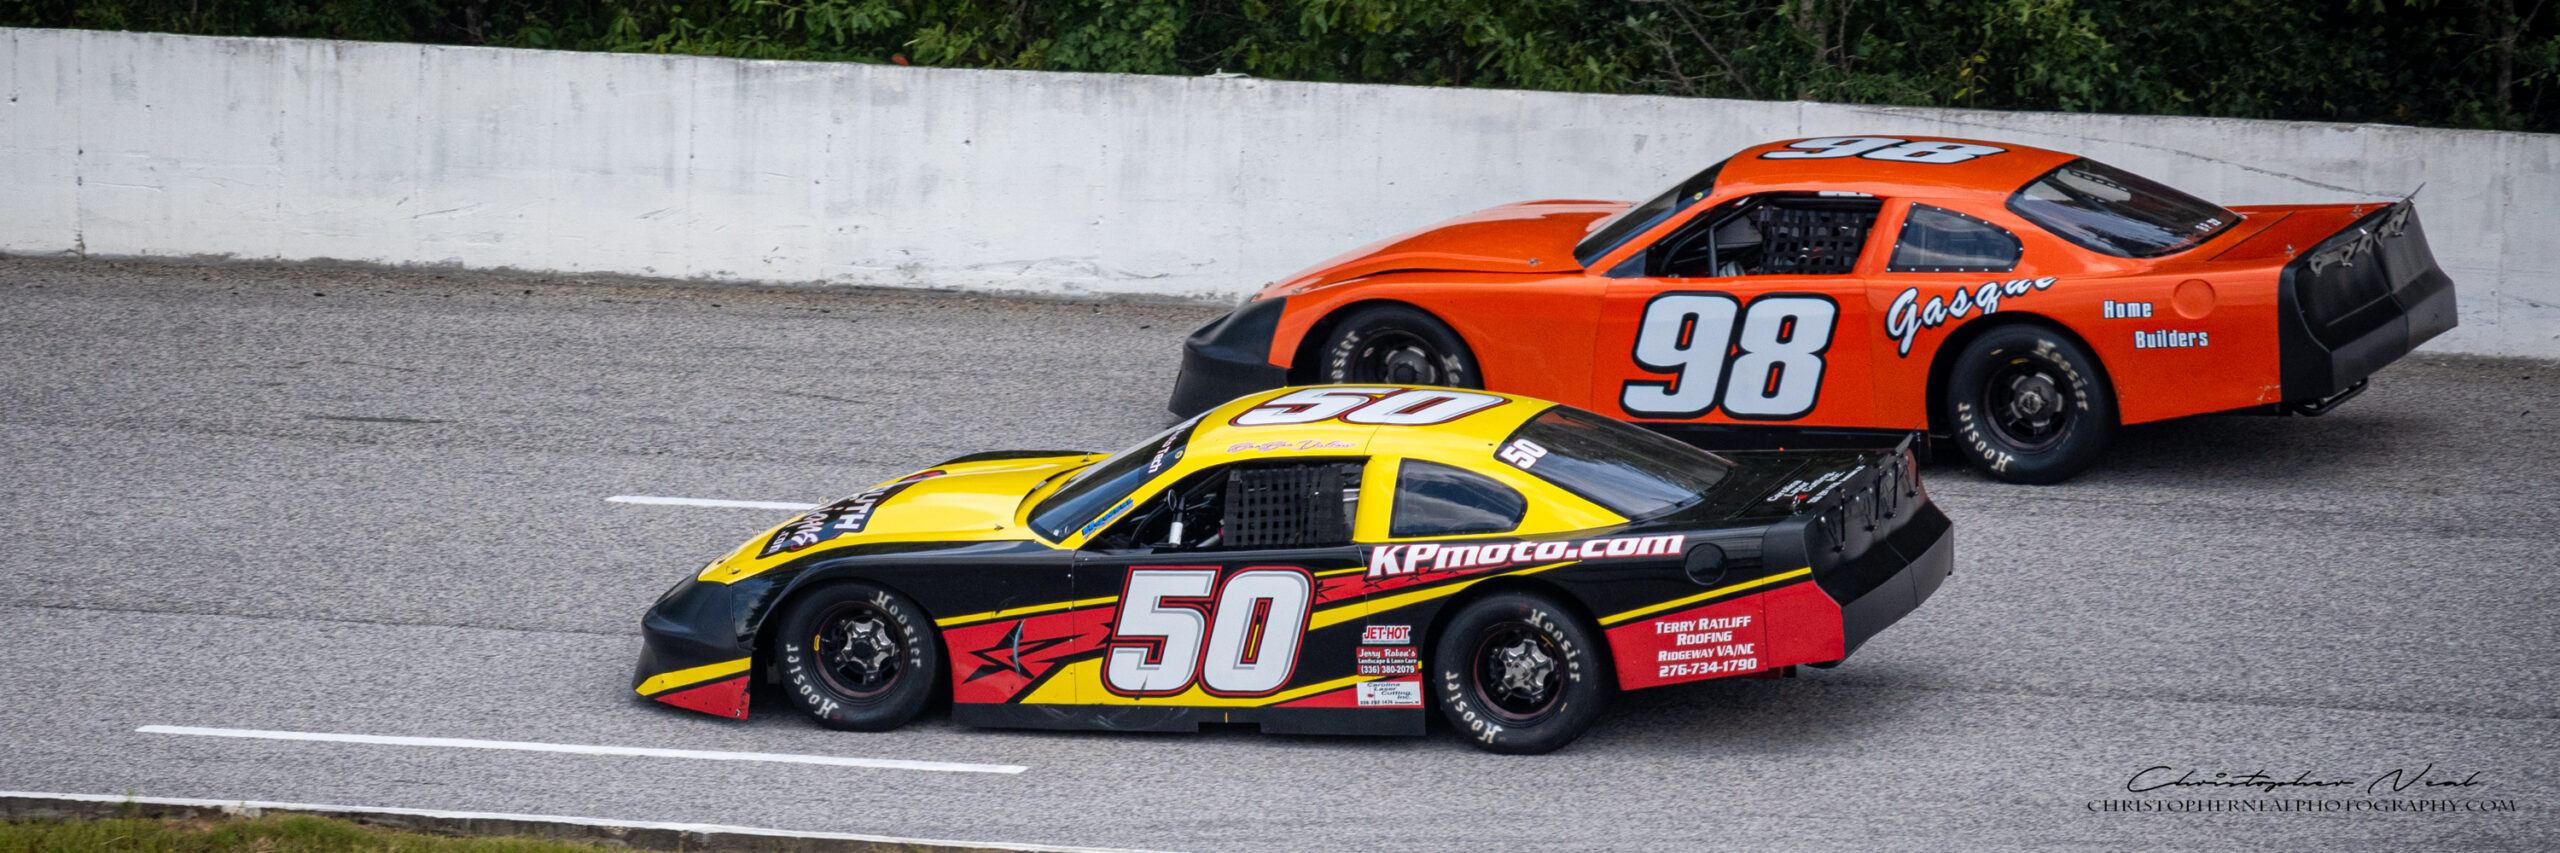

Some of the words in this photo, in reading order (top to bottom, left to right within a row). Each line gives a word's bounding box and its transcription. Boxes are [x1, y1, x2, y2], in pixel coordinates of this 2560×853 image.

[1757, 135, 2009, 165] 98
[2103, 300, 2152, 319] Home
[1619, 290, 1840, 421] 98
[2134, 330, 2209, 349] Builders
[2031, 339, 2088, 412] Hoosier
[1228, 386, 1513, 427] 50
[1500, 437, 1548, 469] 50
[1958, 402, 2015, 472] Hoosier
[1367, 534, 1685, 578] KPmoto.com
[870, 591, 921, 668] Hoosier
[1100, 565, 1315, 698] 50
[1362, 625, 1411, 640] JET-HOT
[1655, 620, 1696, 634] TERRY
[1698, 615, 1752, 631] RATLIFF
[1676, 630, 1733, 646] ROOFING
[1524, 609, 1581, 683] Hoosier
[1658, 647, 1715, 662] RIDGEWAY
[1716, 643, 1755, 657] VA/NC
[786, 643, 839, 719] Hoosier
[1361, 665, 1380, 675] (336)
[1382, 665, 1415, 674] 380-2079
[1658, 657, 1758, 678] 276-734-1790
[1446, 671, 1503, 743] Hoosier
